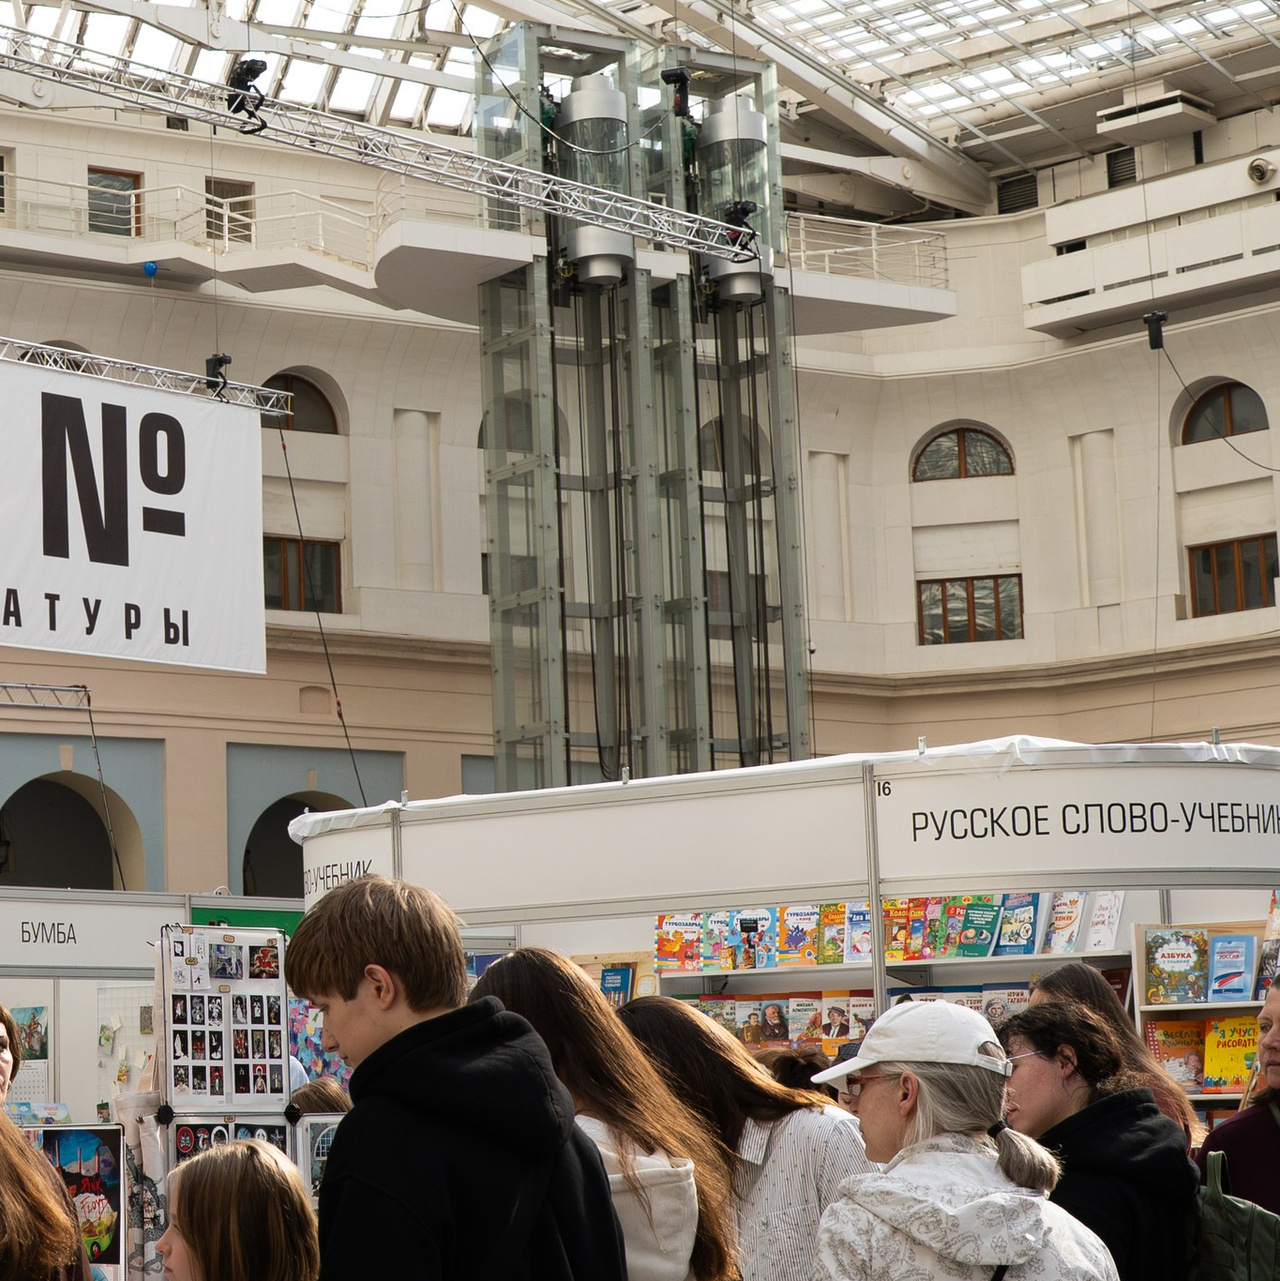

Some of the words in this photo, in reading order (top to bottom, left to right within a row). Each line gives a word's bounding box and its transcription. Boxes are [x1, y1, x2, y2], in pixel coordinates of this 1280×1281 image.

[911, 805, 1051, 842] РУССКОЕ
[21, 920, 77, 945] БУМБА
[1229, 1027, 1258, 1038] УЧУСЬ
[1216, 1038, 1258, 1049] РИСОВАТЬ
